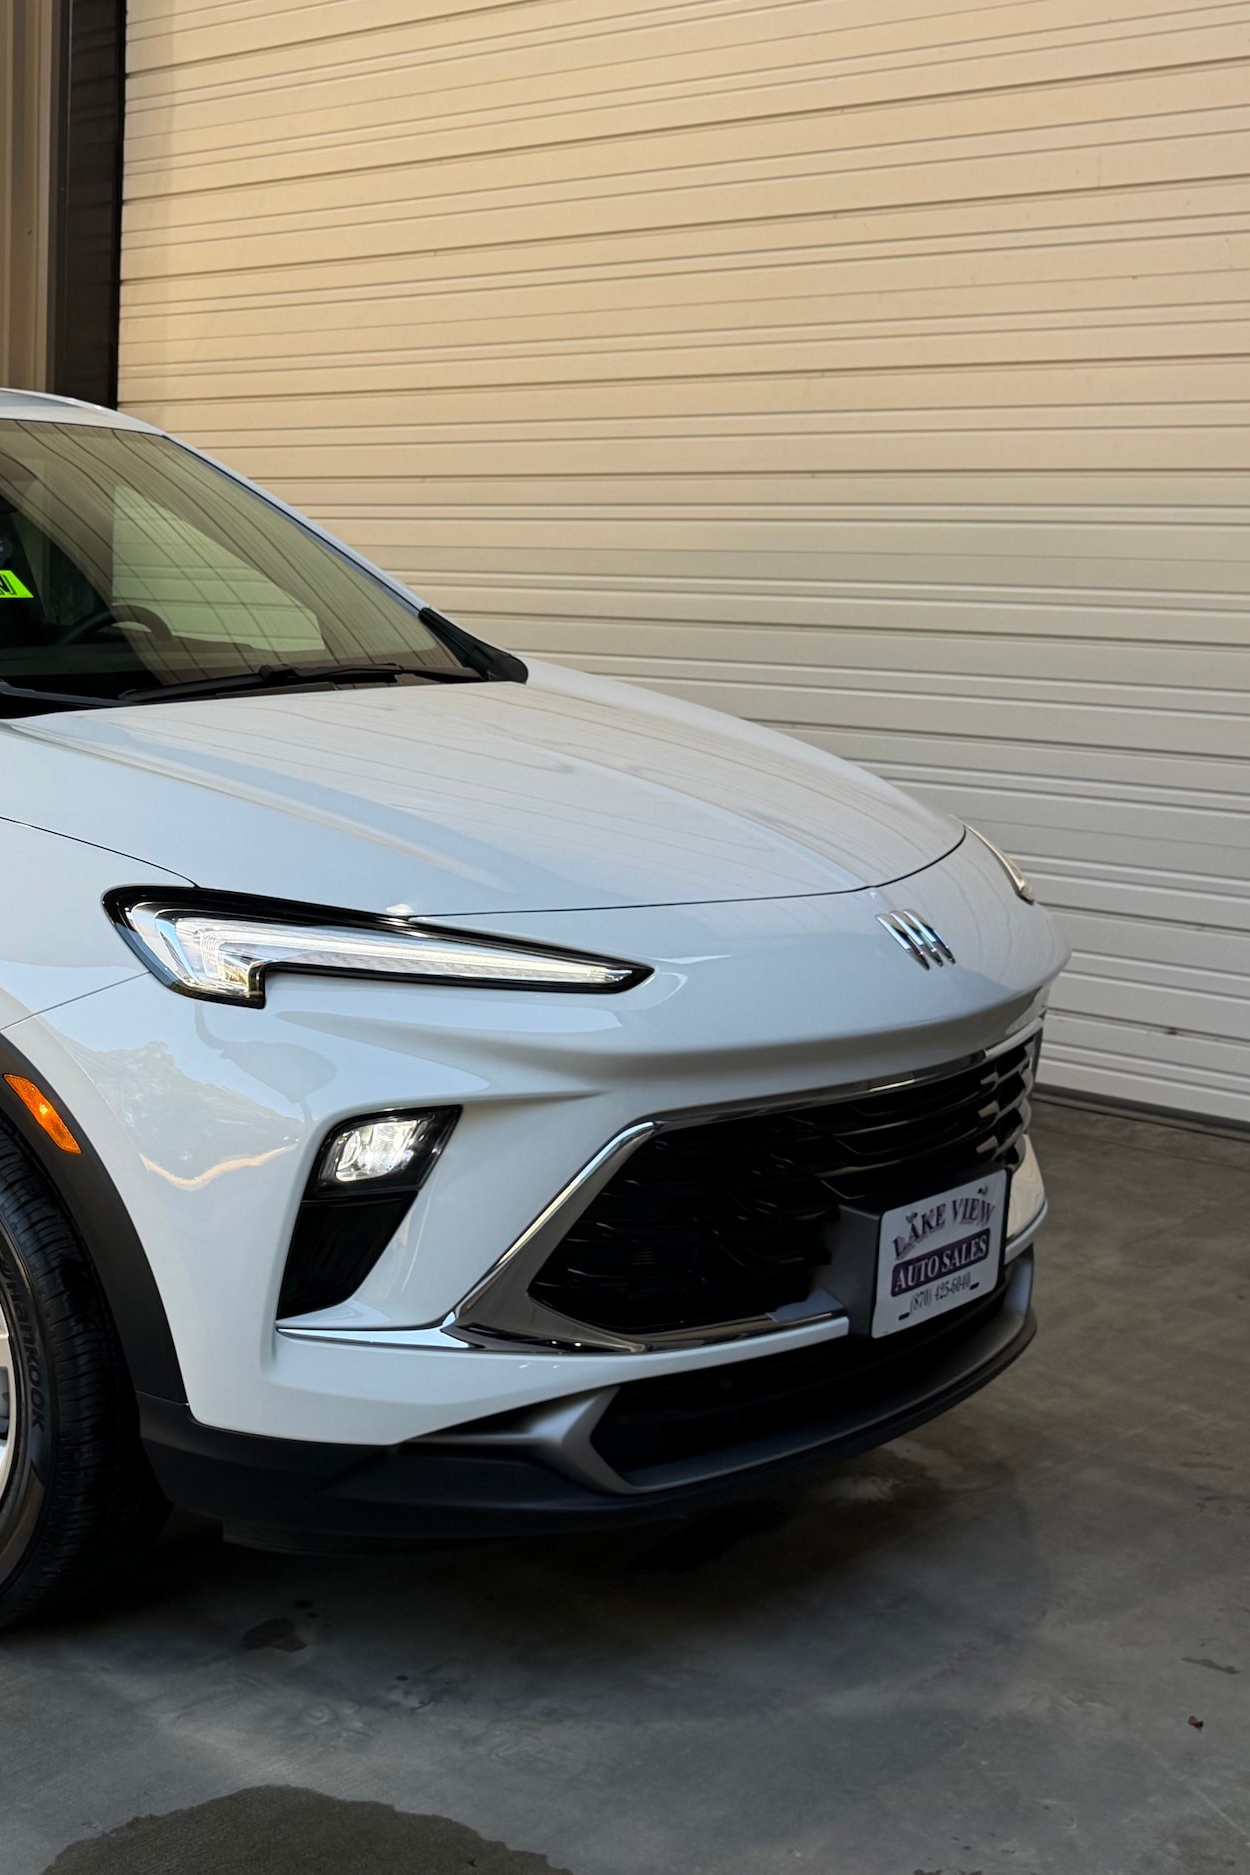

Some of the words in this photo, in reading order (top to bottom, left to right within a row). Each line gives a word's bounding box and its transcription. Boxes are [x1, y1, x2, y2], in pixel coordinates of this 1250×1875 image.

[892, 1203, 946, 1260] LAKE
[952, 1198, 995, 1227] VIEW
[895, 1256, 938, 1292] AUTO
[942, 1235, 987, 1272] SALES
[909, 1289, 932, 1313] (870)
